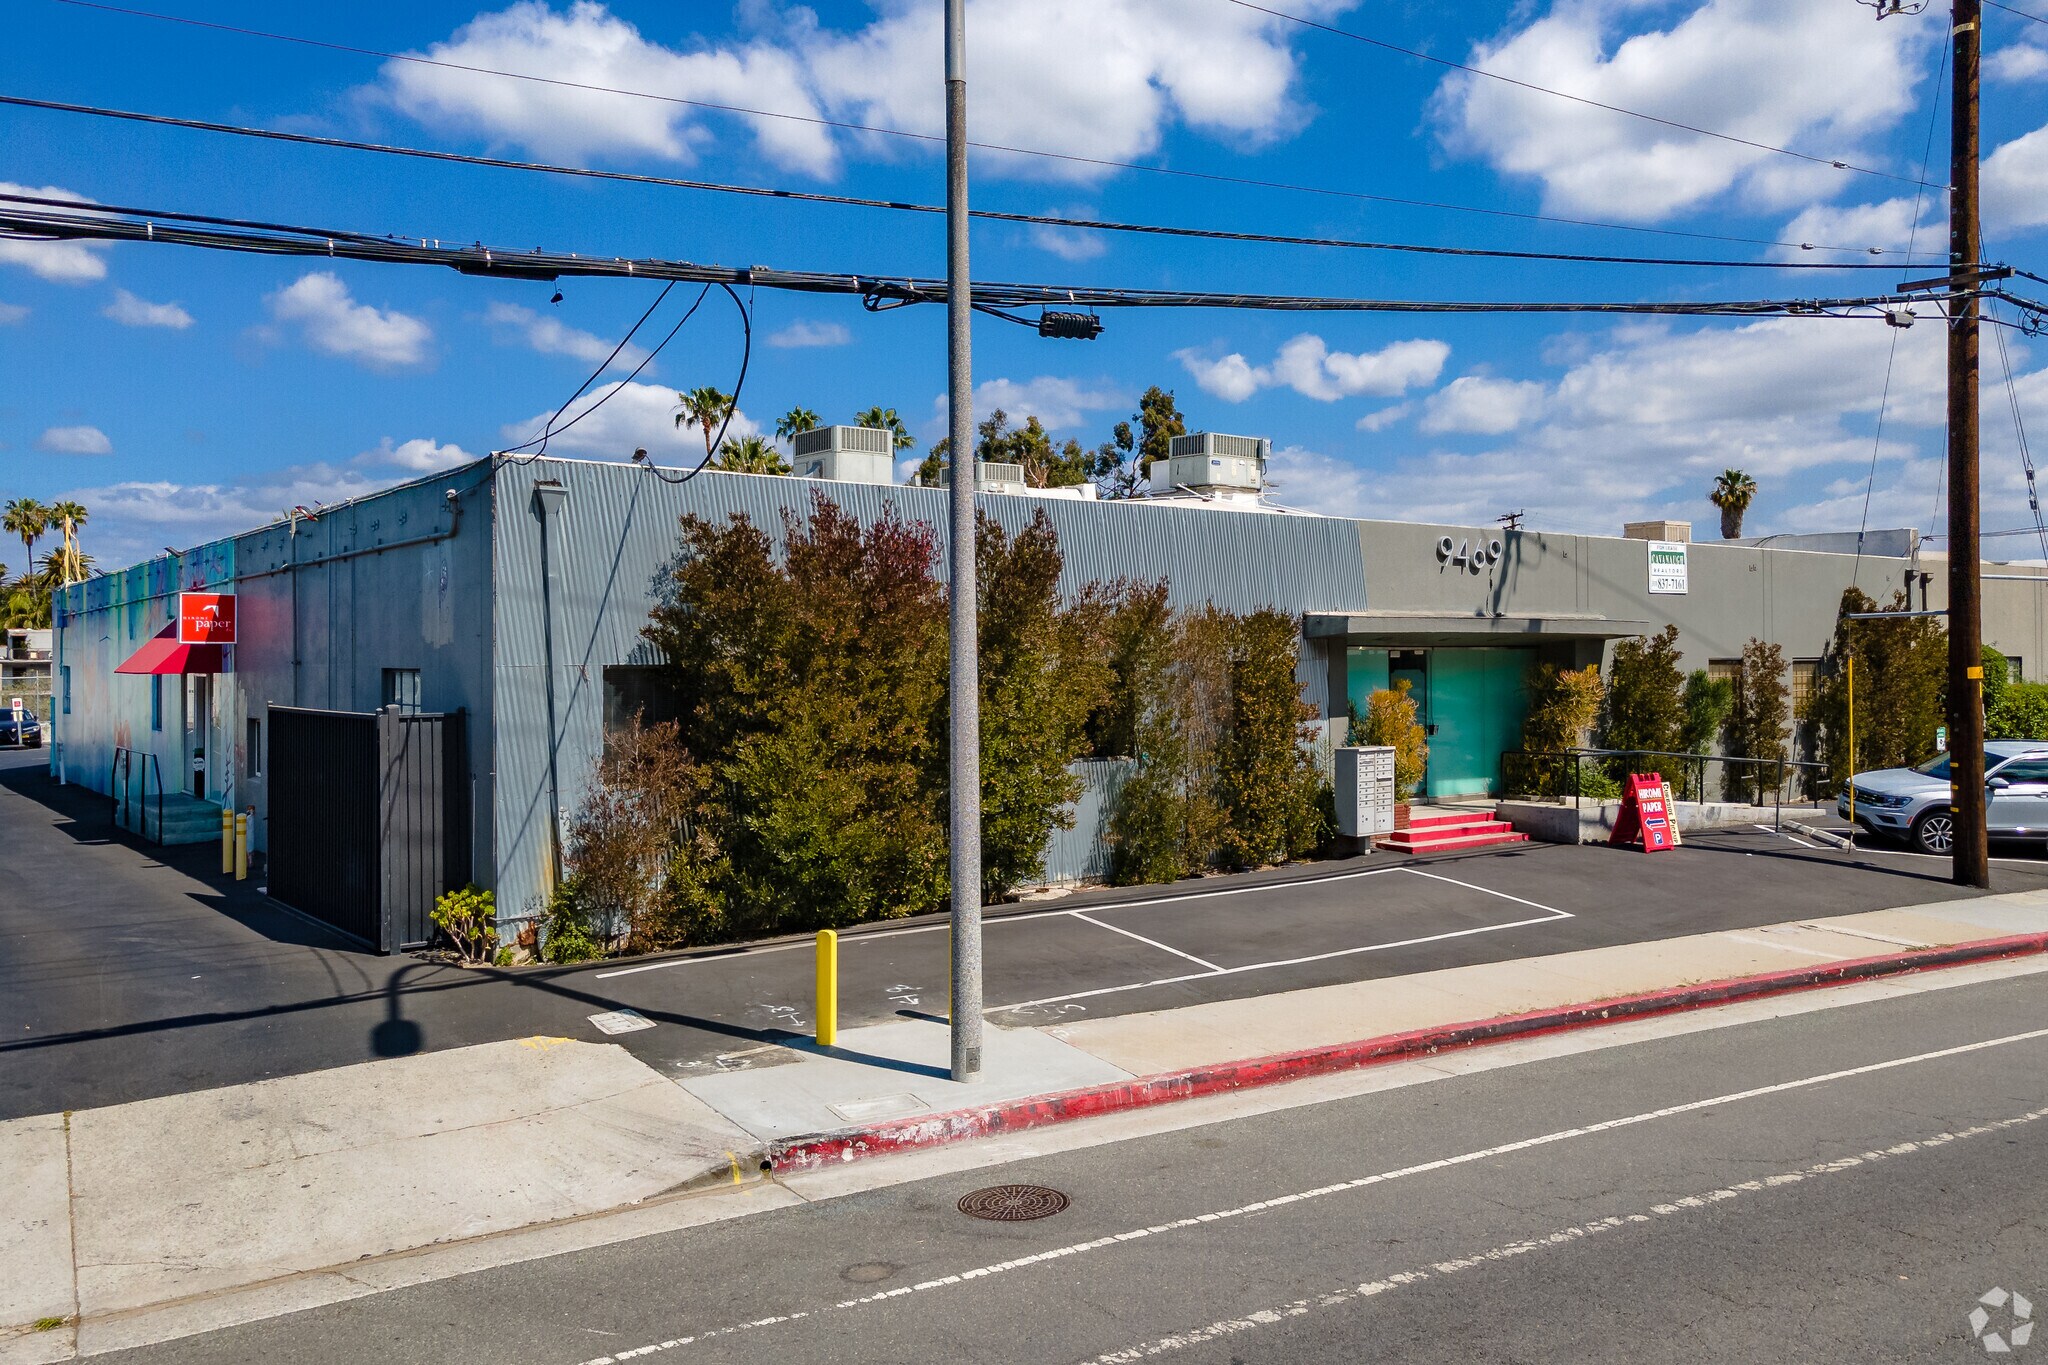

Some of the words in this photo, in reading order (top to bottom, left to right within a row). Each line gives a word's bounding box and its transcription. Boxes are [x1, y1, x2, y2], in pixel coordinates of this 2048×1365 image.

[1436, 536, 1502, 569] 9469
[1657, 578, 1685, 589] 837-7161
[195, 620, 231, 632] paper
[1638, 788, 1662, 799] HIROMI
[1642, 801, 1663, 813] PAPER
